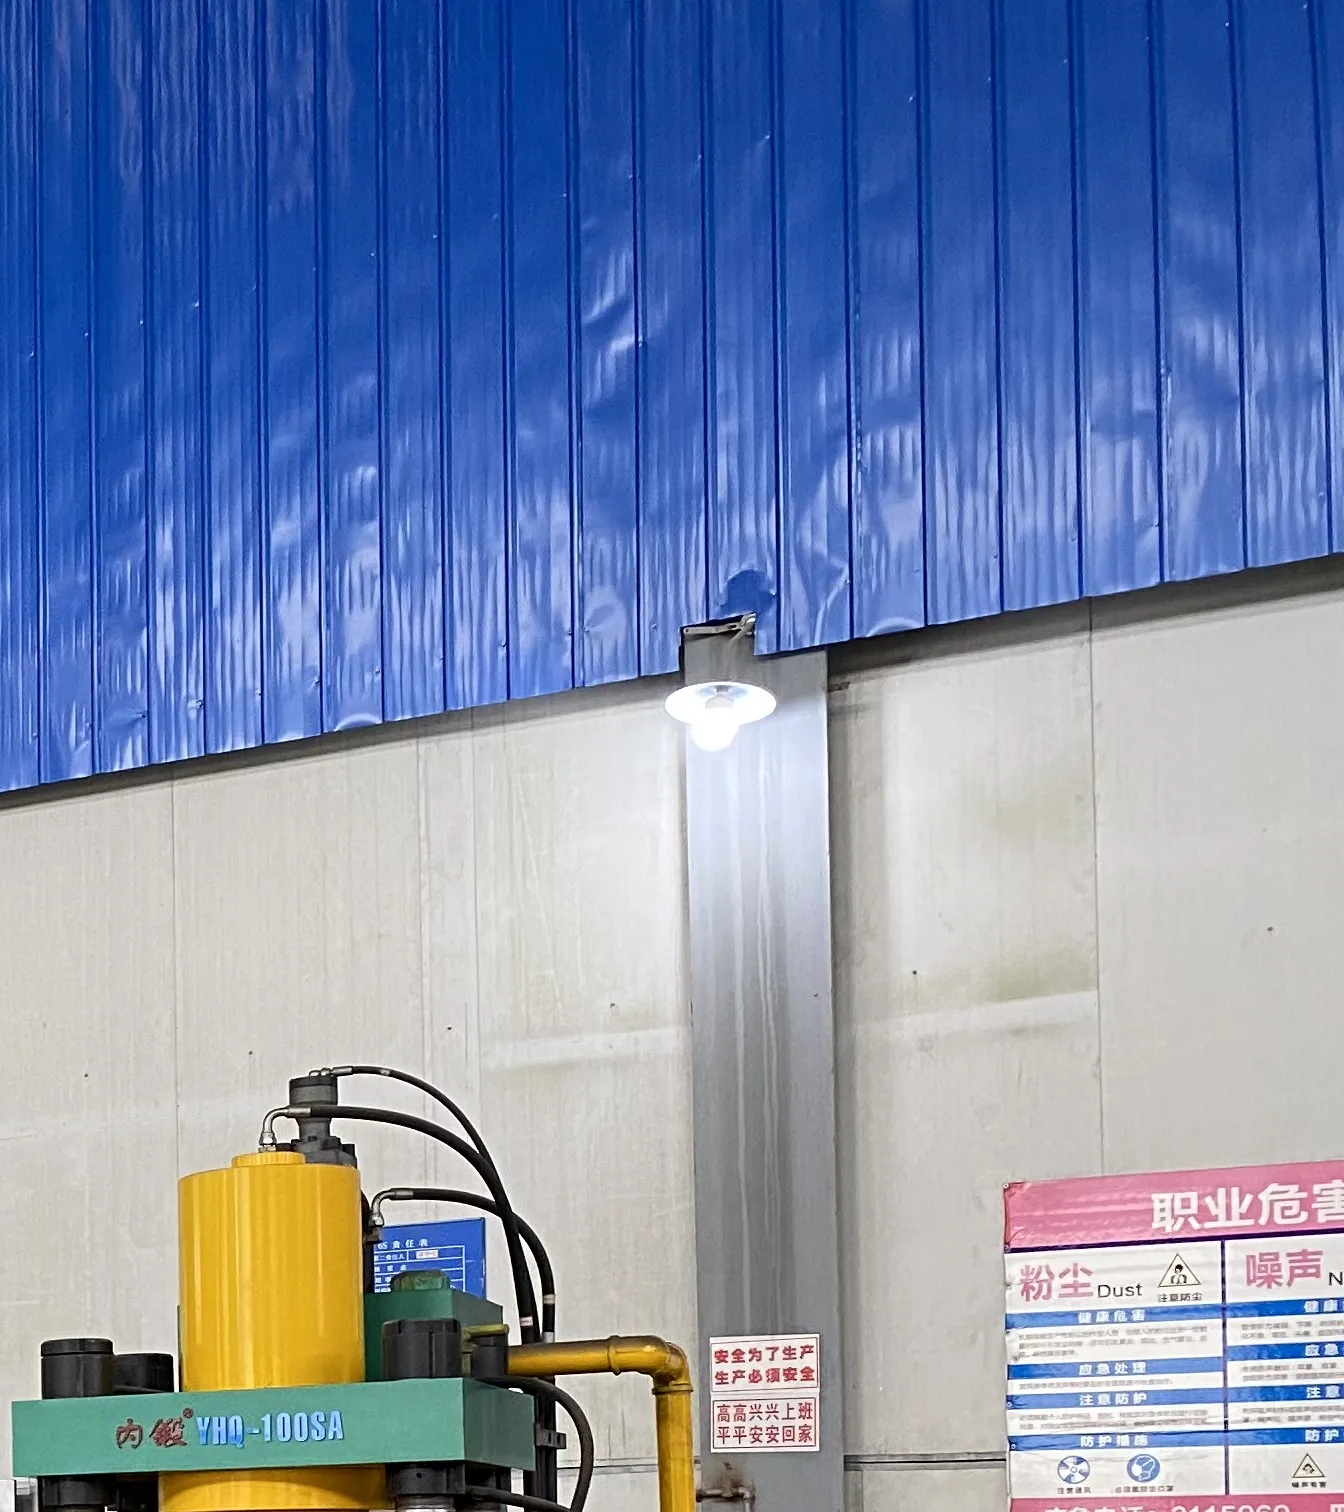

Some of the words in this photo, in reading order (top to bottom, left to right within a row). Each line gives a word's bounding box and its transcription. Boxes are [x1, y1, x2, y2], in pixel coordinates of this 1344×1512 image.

[1151, 1182, 1344, 1233] 职业危害
[1245, 1248, 1324, 1290] 噪声
[1019, 1262, 1094, 1302] 粉尘
[1097, 1283, 1143, 1298] Dust
[1077, 1309, 1146, 1324] 健康危害
[714, 1344, 815, 1365] 安全为了生产
[714, 1366, 815, 1386] 生产必须安全
[1078, 1361, 1147, 1376] 应急处理
[1079, 1391, 1148, 1406] 注意防护
[716, 1401, 813, 1423] 高高兴兴上班
[196, 1410, 345, 1449] YHQ-100SA
[716, 1423, 813, 1445] 平平安安回家
[1080, 1432, 1149, 1448] 防护措施
